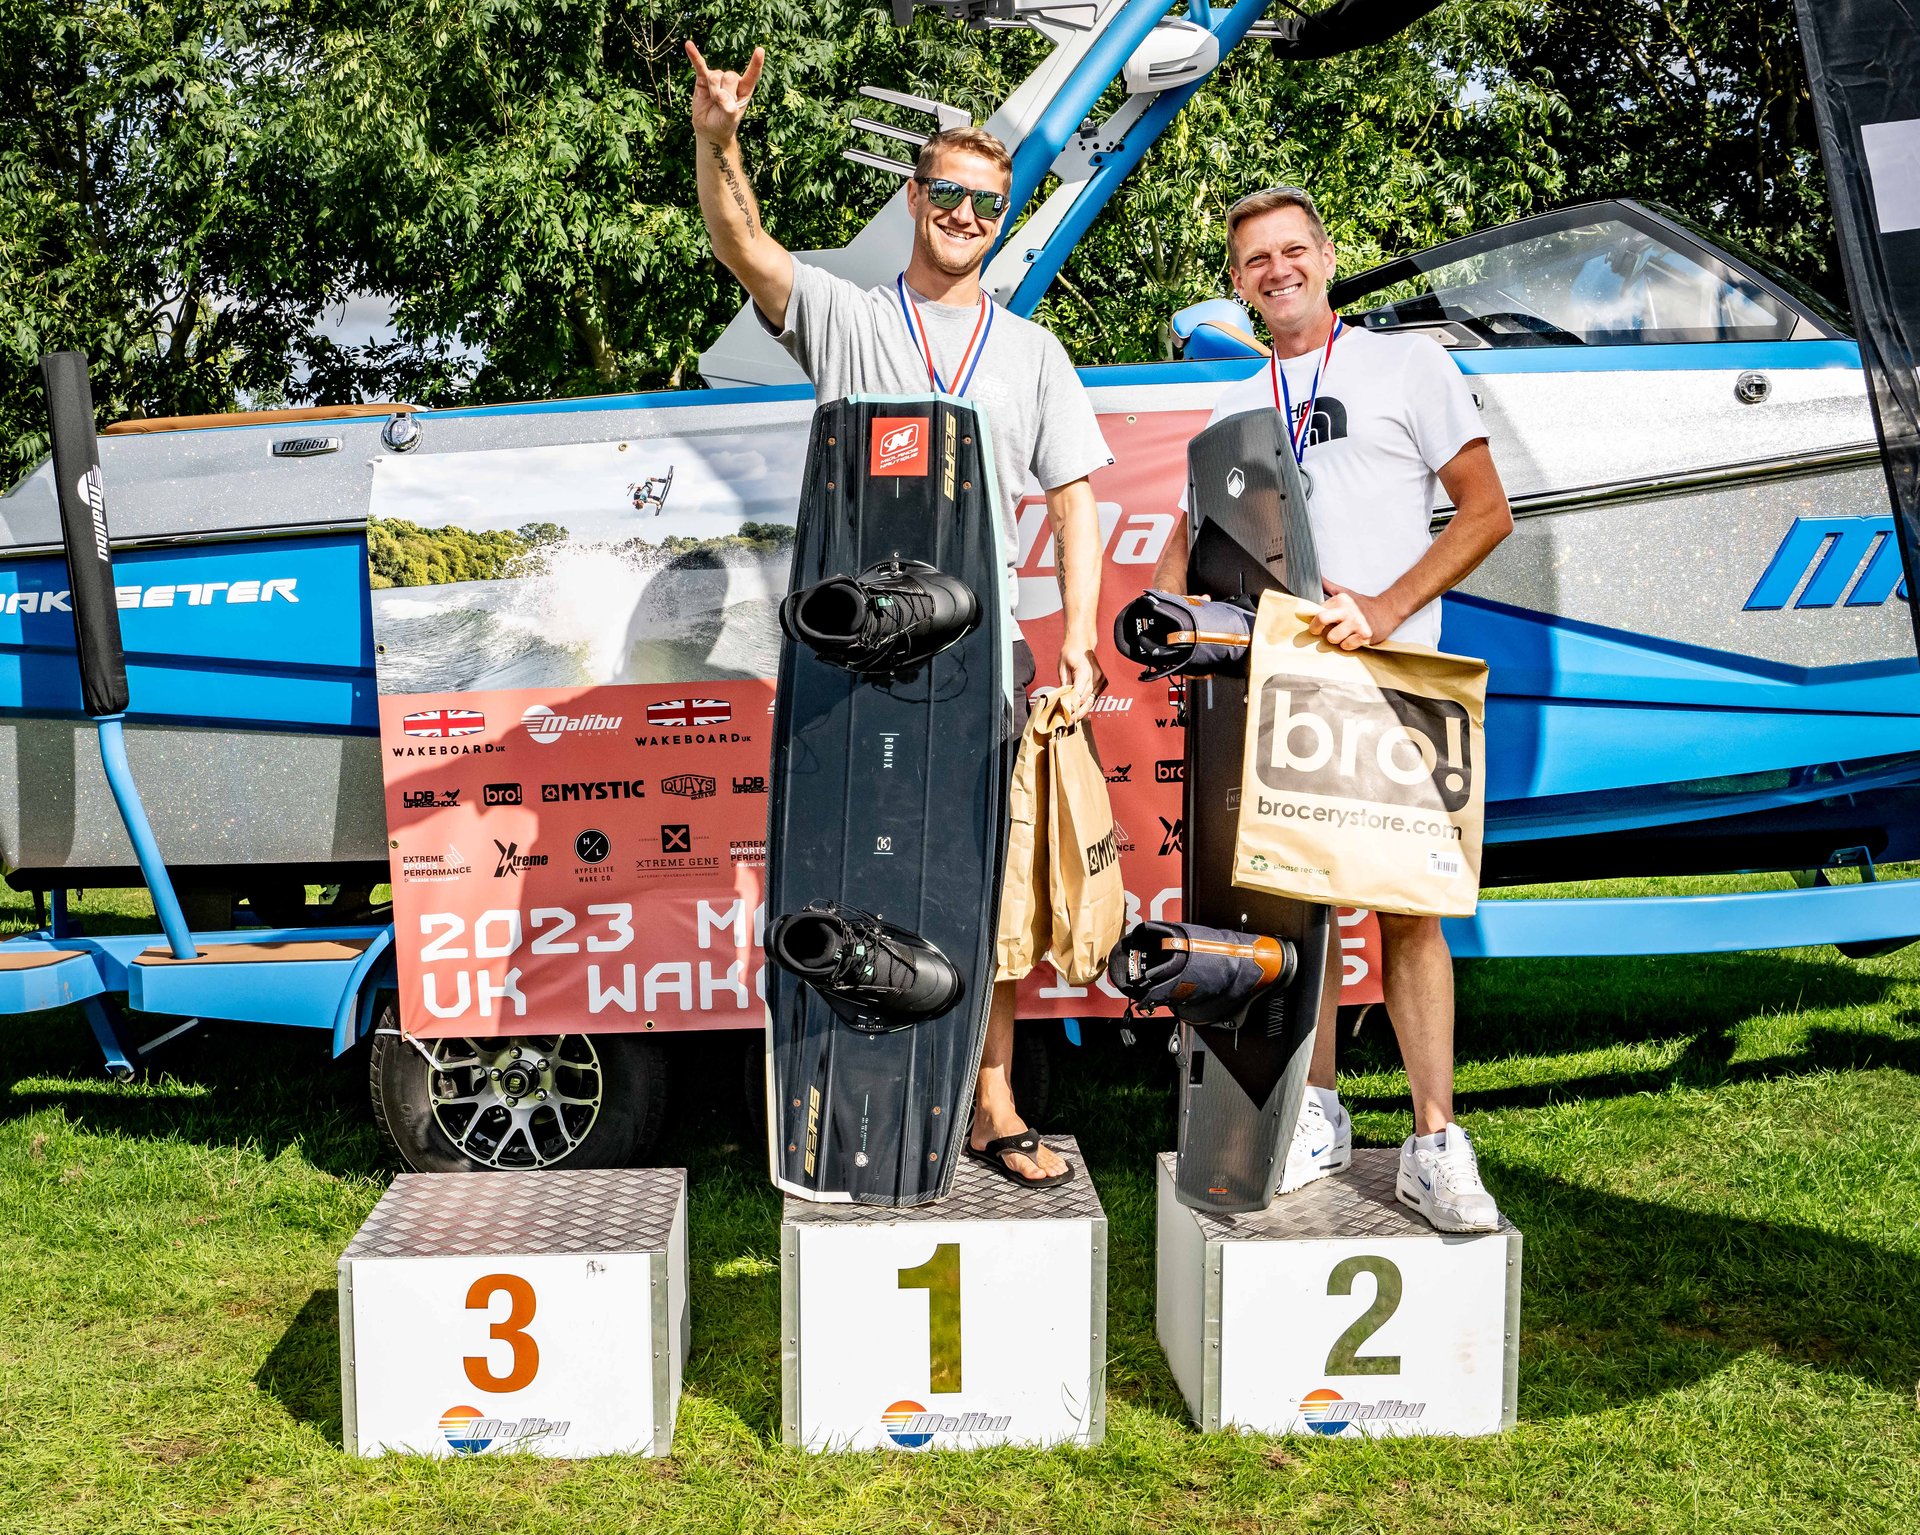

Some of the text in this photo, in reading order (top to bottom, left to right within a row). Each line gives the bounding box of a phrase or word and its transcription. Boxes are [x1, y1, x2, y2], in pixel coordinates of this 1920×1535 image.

[281, 438, 328, 452] Malibu
[88, 482, 109, 563] Malibu
[540, 714, 623, 732] Malibu
[1270, 689, 1464, 793] bro!
[883, 737, 894, 769] RONIX
[561, 780, 645, 801] MYSTIC
[664, 776, 713, 795] QUAYS
[732, 776, 764, 788] LDB
[403, 790, 435, 801] LDB
[486, 785, 522, 802] bro!
[1257, 796, 1463, 841] brocerystore.com
[730, 840, 767, 848] EXTREM
[730, 847, 767, 855] SPORTS
[402, 855, 445, 863] EXTREME
[403, 862, 438, 870] SPORTS
[493, 839, 549, 878] Xtreme
[636, 857, 719, 868] XTREME GENE
[403, 866, 472, 877] PERFORMANCE
[574, 866, 614, 875] HYPERLITE
[579, 875, 598, 883] WAKE
[1273, 863, 1330, 876] please recycle
[420, 902, 635, 963] 2023
[422, 966, 527, 1019] UK
[898, 1243, 962, 1394] 1
[1324, 1255, 1402, 1377] 2
[462, 1273, 540, 1394] 3
[1323, 1400, 1427, 1421] Malibu
[464, 1418, 571, 1439] Malibu
[907, 1412, 1012, 1433] Malibu
